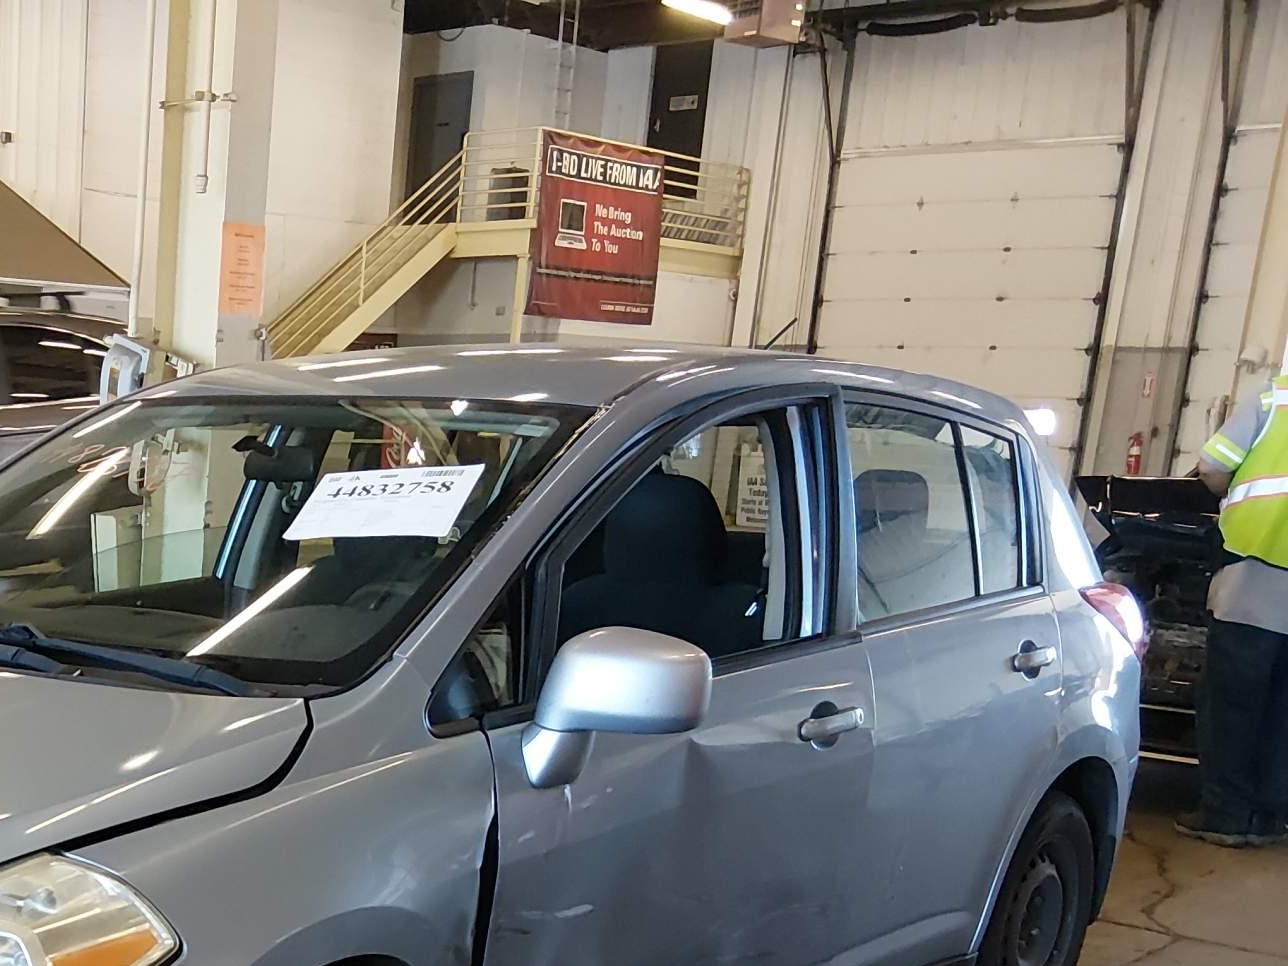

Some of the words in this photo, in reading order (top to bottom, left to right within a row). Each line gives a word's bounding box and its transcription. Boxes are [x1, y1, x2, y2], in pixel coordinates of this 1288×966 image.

[581, 157, 606, 181] LIVE
[606, 162, 637, 187] FROM
[593, 221, 609, 236] The
[591, 238, 601, 252] To
[603, 239, 619, 254] You
[327, 481, 456, 498] 44832758
